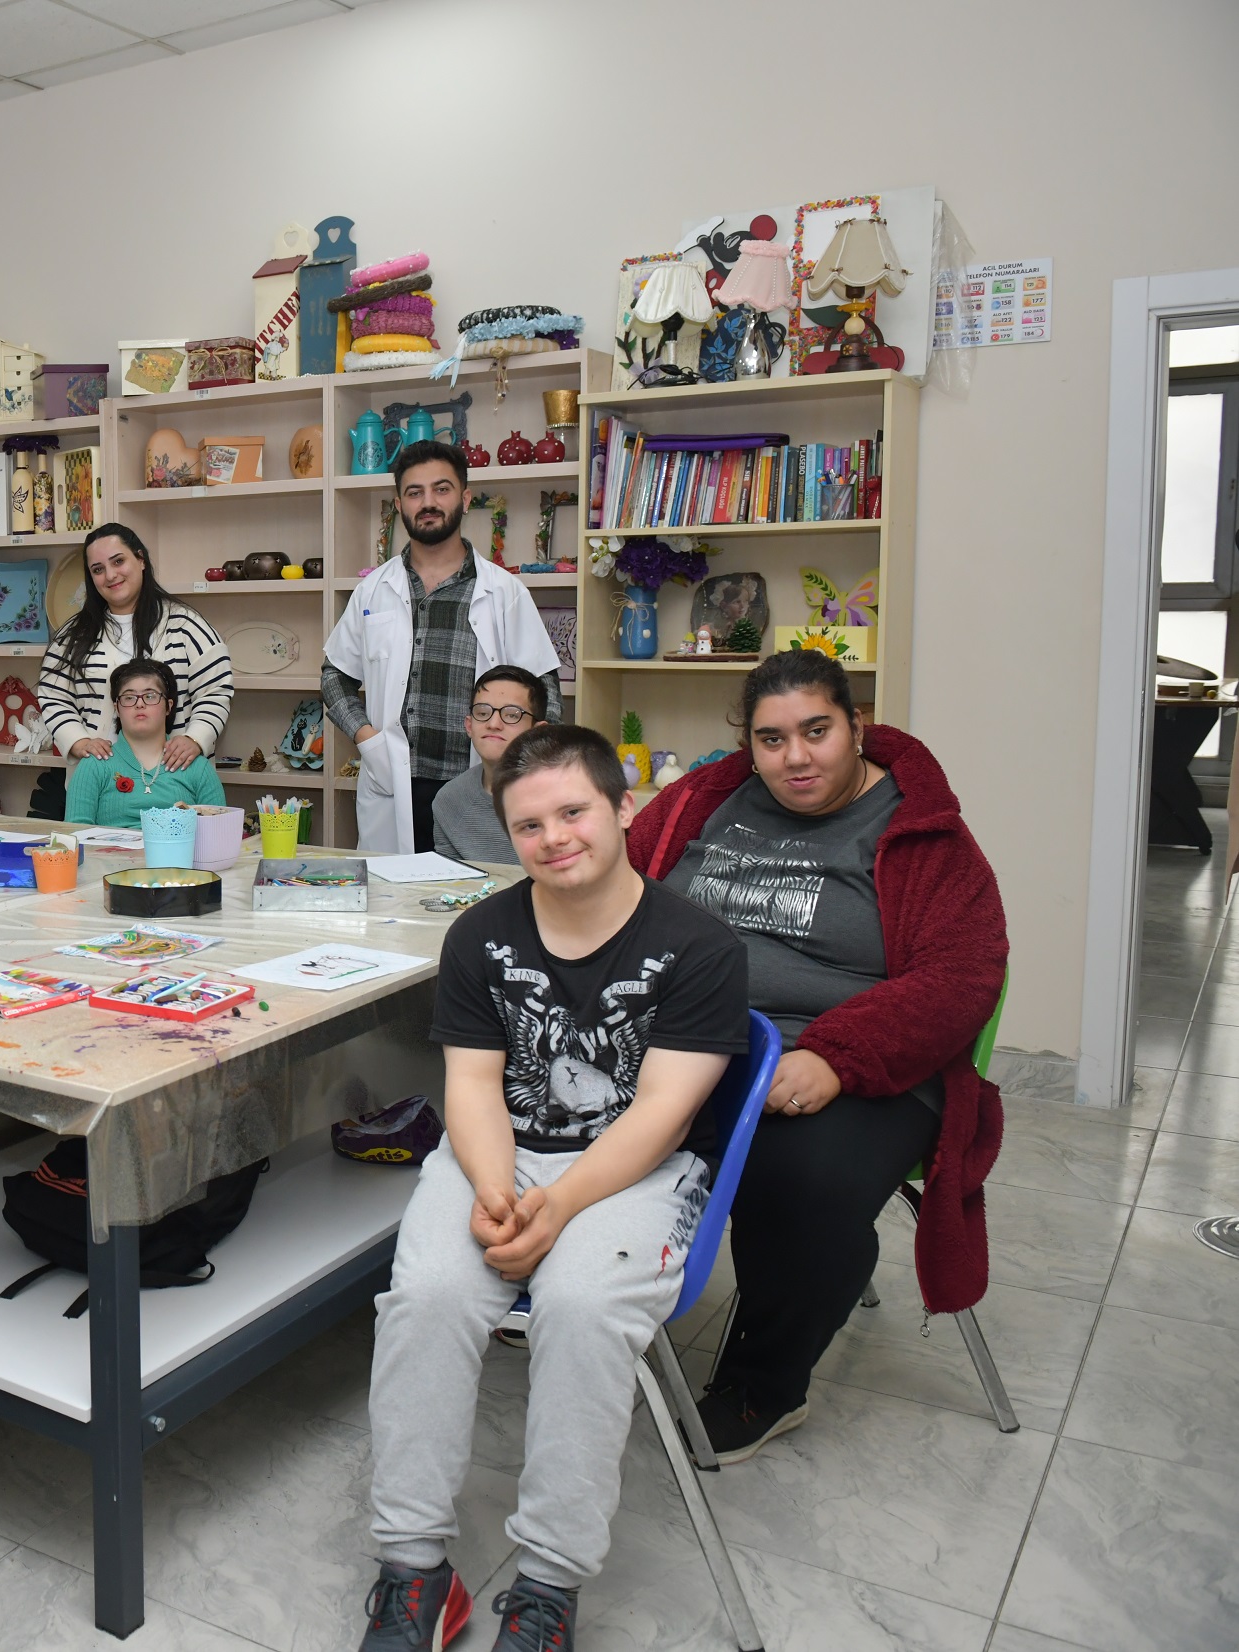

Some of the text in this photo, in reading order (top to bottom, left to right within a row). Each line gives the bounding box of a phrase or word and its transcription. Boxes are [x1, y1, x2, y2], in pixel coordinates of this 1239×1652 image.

[998, 262, 1023, 271] DURUM
[966, 267, 1040, 280] TELEFON NUMARALARI
[798, 446, 806, 475] PLASEBO
[509, 970, 541, 982] KING
[610, 982, 644, 996] EAGLE
